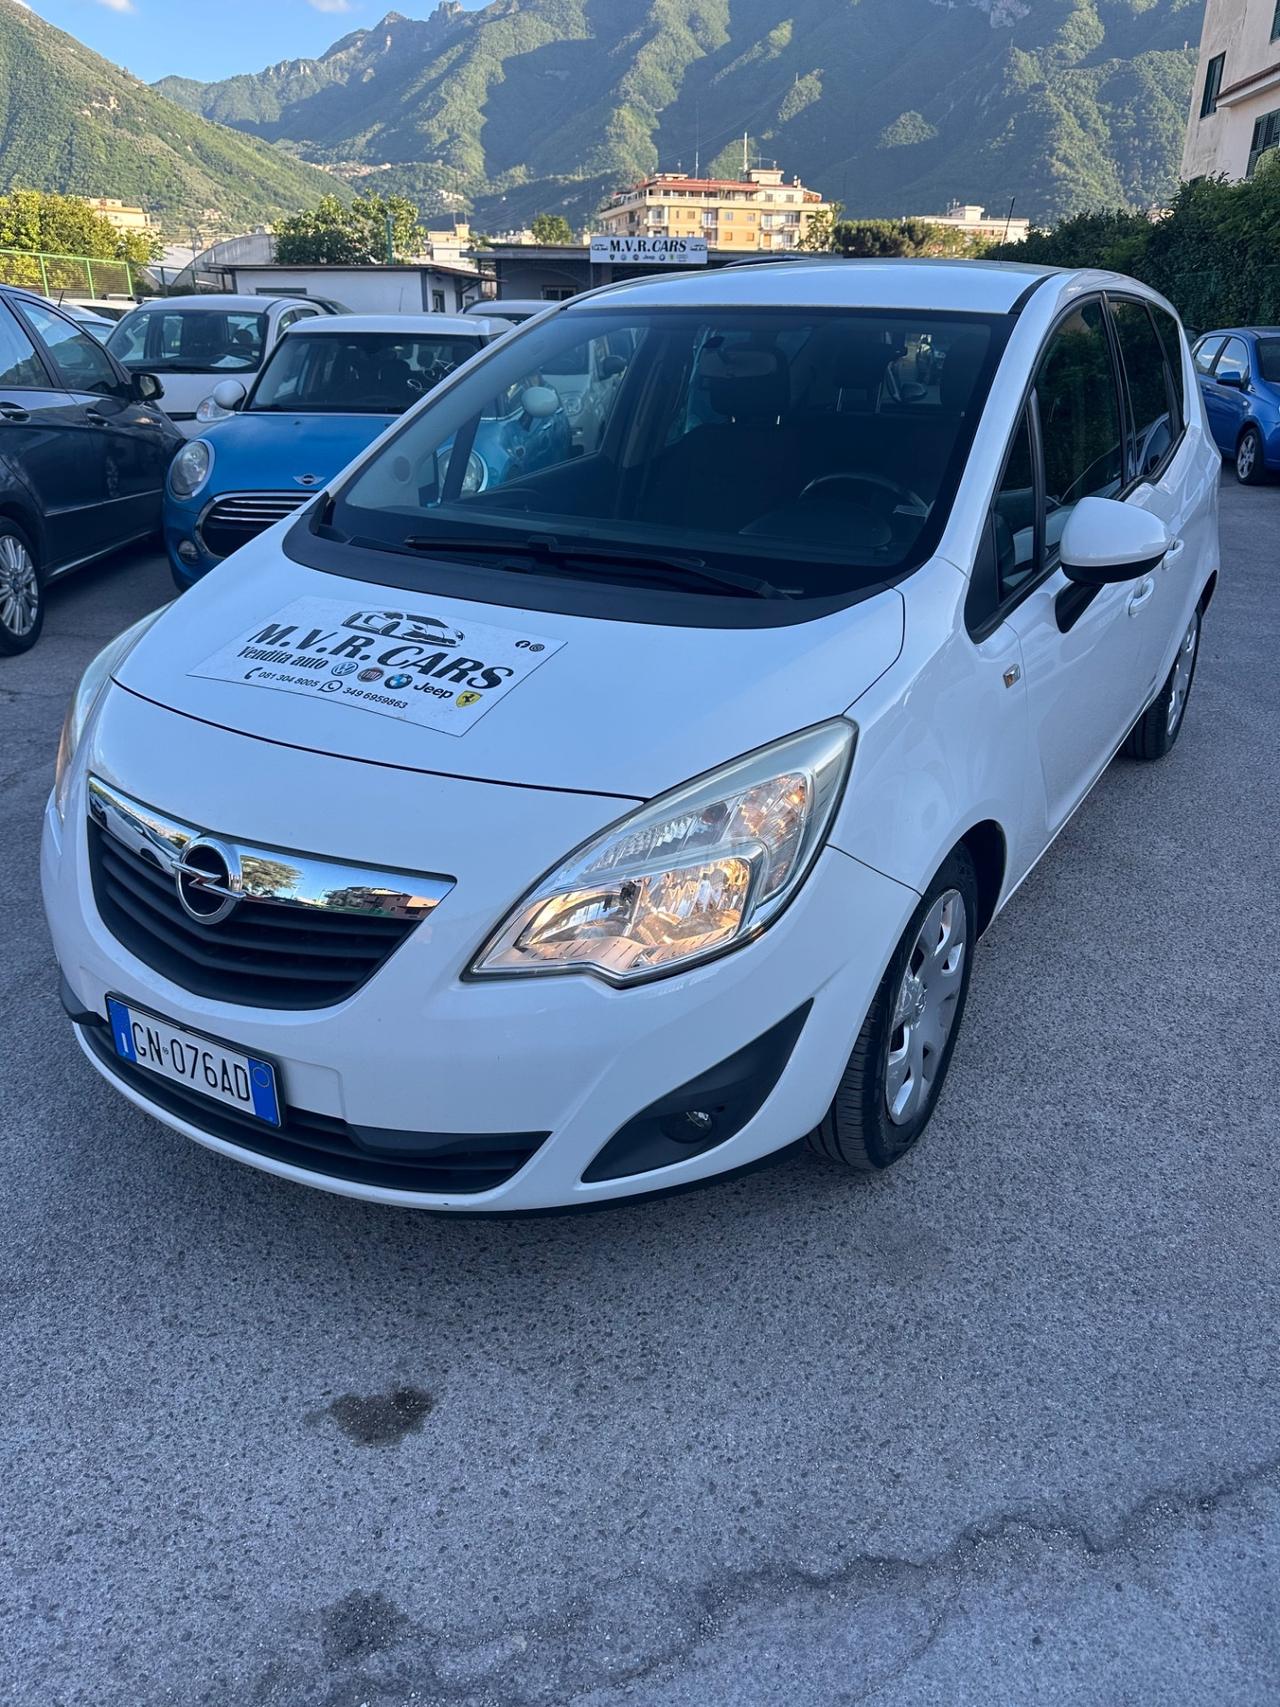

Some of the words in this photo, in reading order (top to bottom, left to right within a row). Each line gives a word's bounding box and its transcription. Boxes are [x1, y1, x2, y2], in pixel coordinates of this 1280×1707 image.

[237, 646, 293, 664] Vendita
[290, 656, 329, 669] auto
[258, 671, 277, 680] 081
[342, 687, 363, 697] 349
[362, 691, 408, 709] 6959863
[413, 682, 454, 699] Jeep
